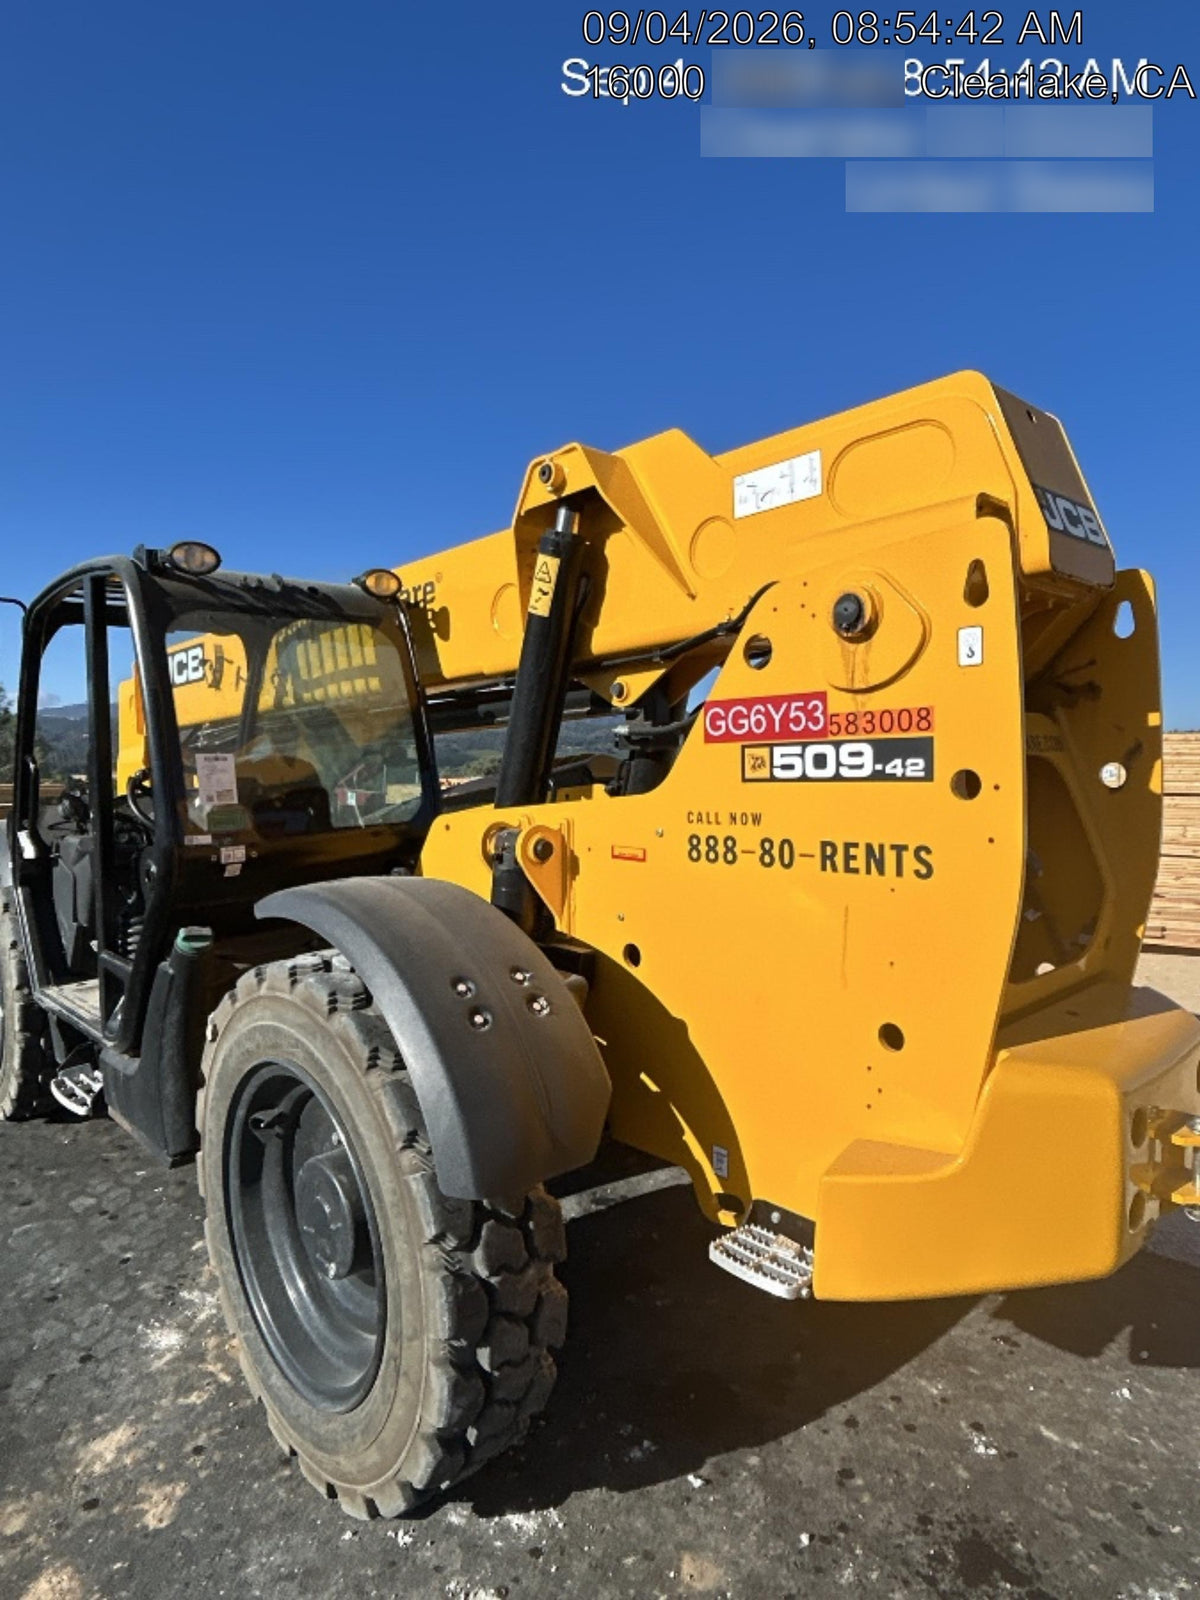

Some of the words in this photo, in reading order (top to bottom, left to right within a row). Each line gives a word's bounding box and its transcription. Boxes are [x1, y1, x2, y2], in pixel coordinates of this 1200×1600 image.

[1042, 490, 1107, 546] JCB
[705, 700, 825, 736] GG6Y53
[829, 707, 932, 736] 583008
[772, 743, 926, 779] 509-42
[687, 811, 722, 825] CALL
[729, 812, 763, 826] NOW
[687, 834, 934, 880] 888-80-RENTS
